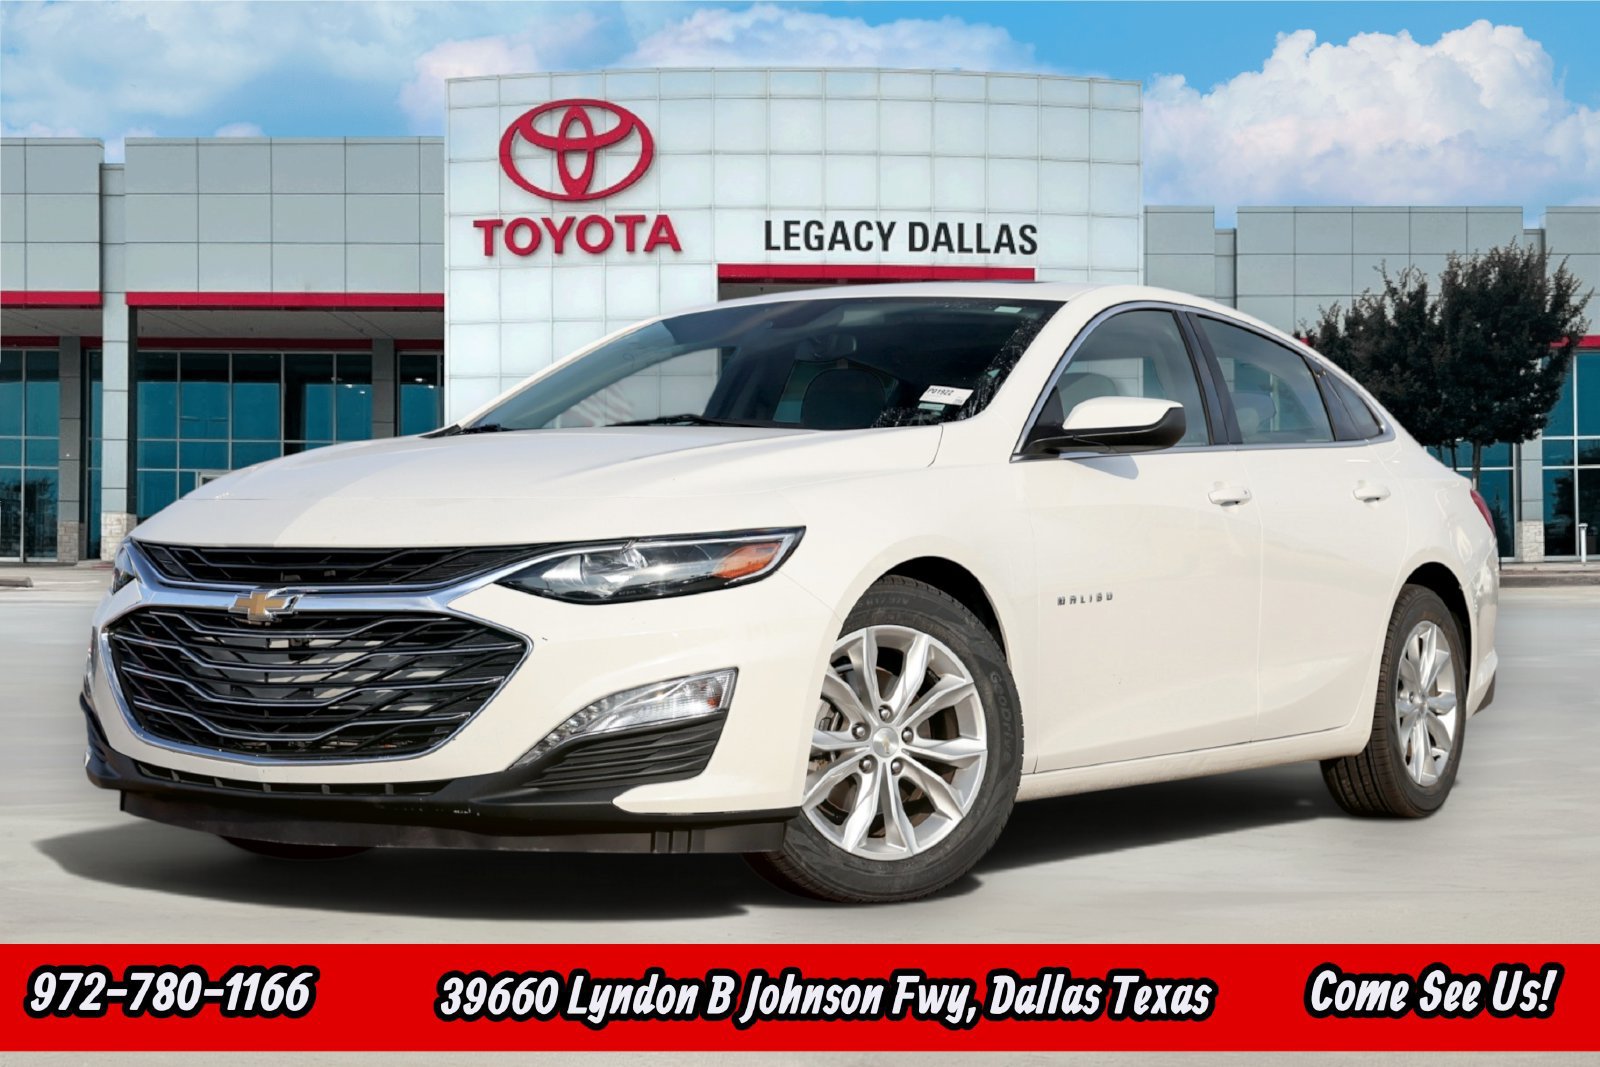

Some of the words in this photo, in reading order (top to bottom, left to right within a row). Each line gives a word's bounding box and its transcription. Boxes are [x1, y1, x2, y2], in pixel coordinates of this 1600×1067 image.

[474, 214, 681, 257] TOYOTA
[765, 220, 896, 252] LEGACY
[908, 221, 1038, 255] DALLAS
[1057, 592, 1113, 606] MALIBU
[989, 670, 1014, 763] GeoDrive
